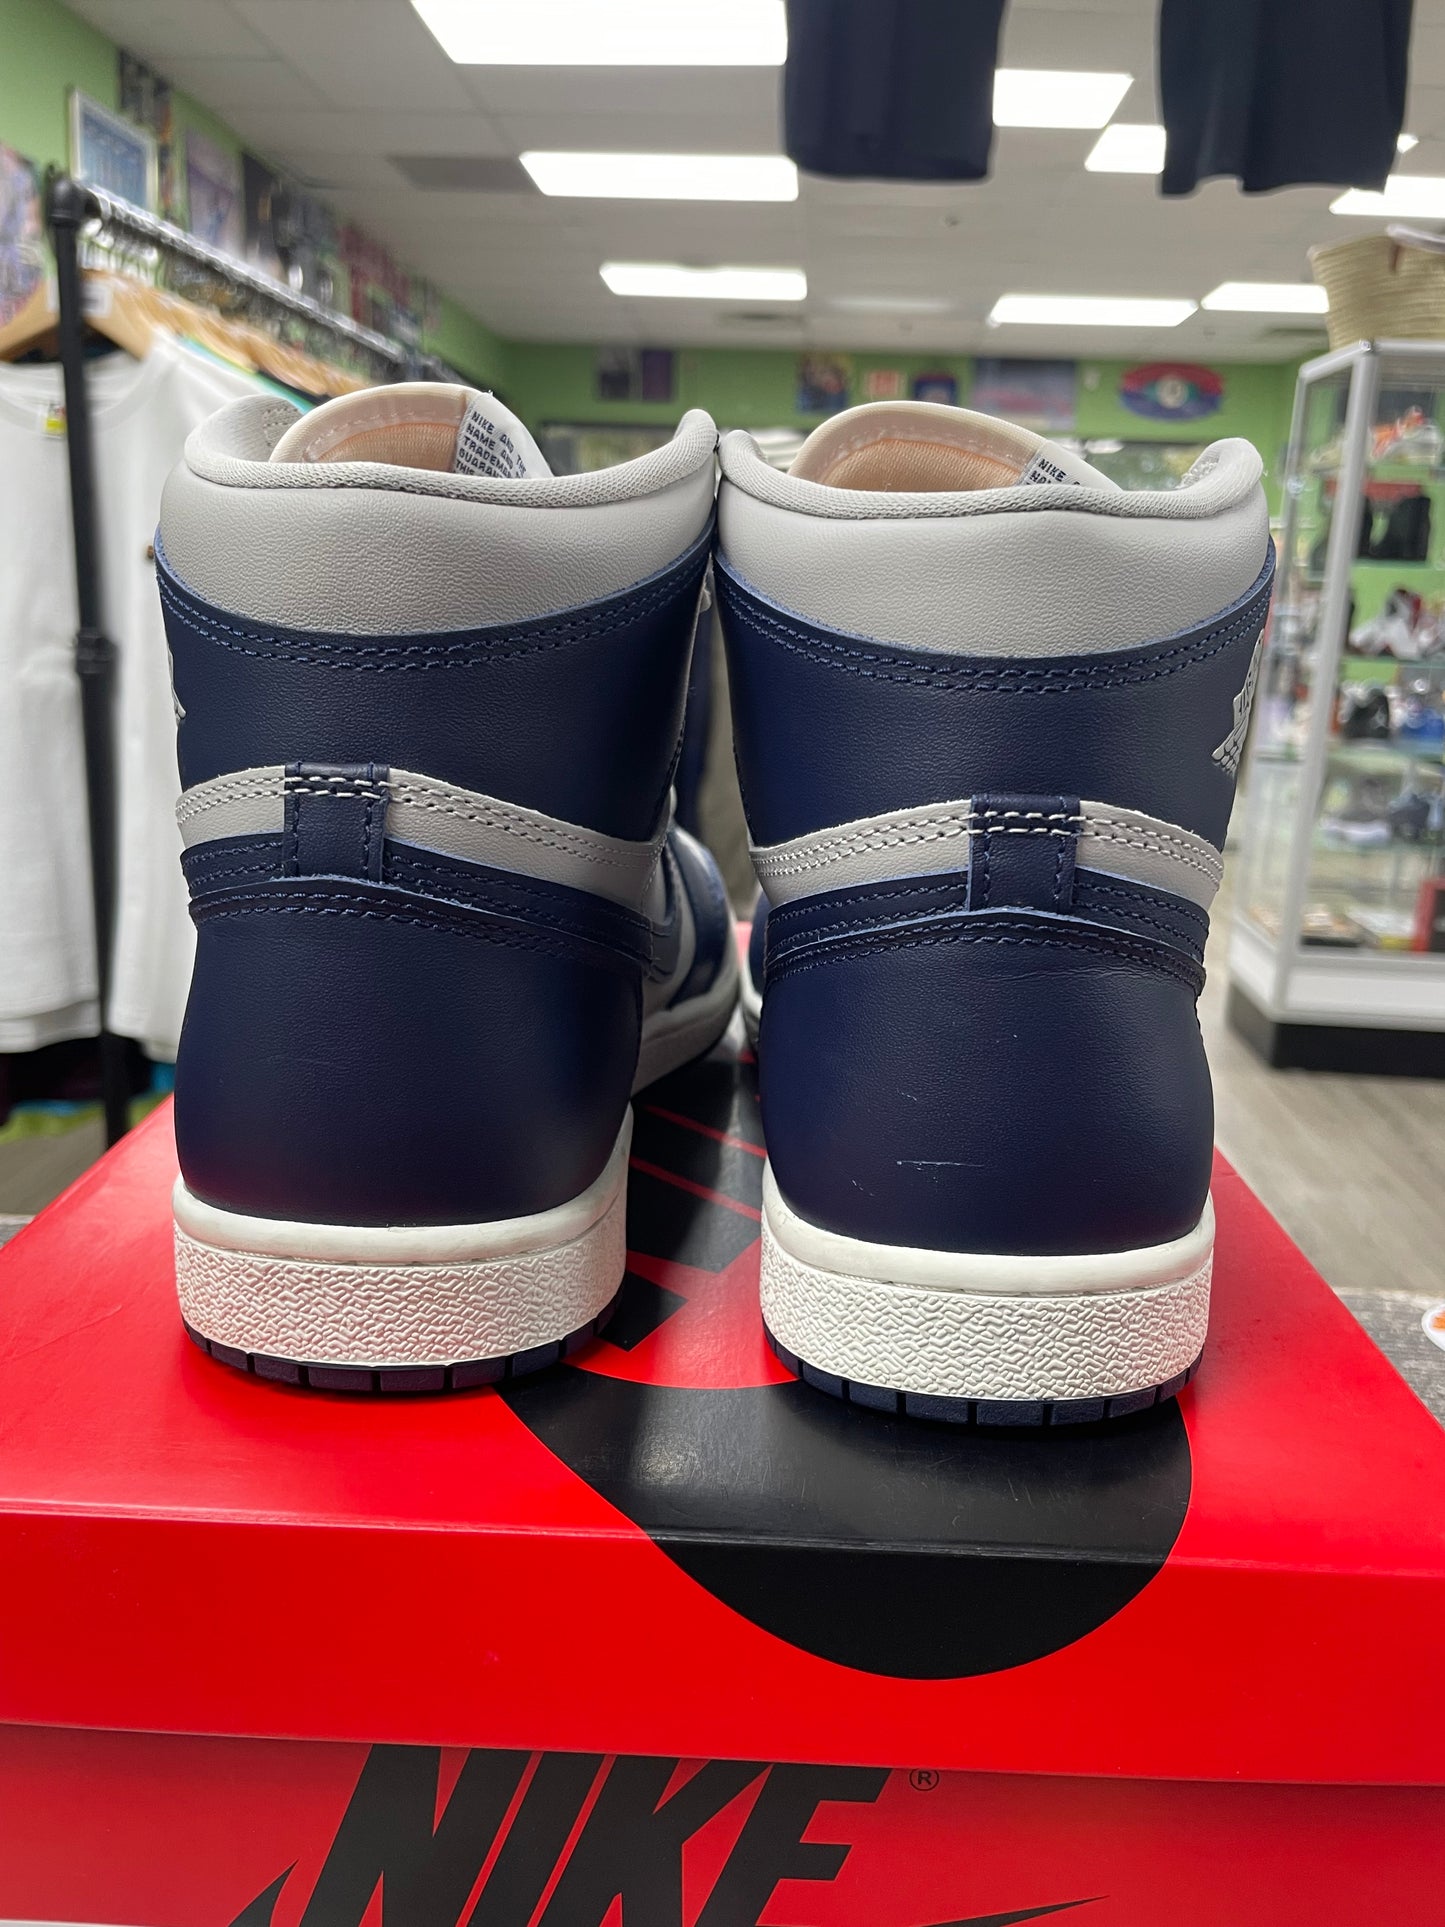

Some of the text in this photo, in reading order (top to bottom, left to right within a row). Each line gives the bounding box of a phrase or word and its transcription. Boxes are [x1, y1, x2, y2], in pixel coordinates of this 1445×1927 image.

[466, 423, 496, 451] NAME
[471, 411, 495, 435] NIKE
[459, 448, 504, 478] GUARAN
[1038, 458, 1067, 482] NIKE
[300, 1743, 893, 1927] NIKE
